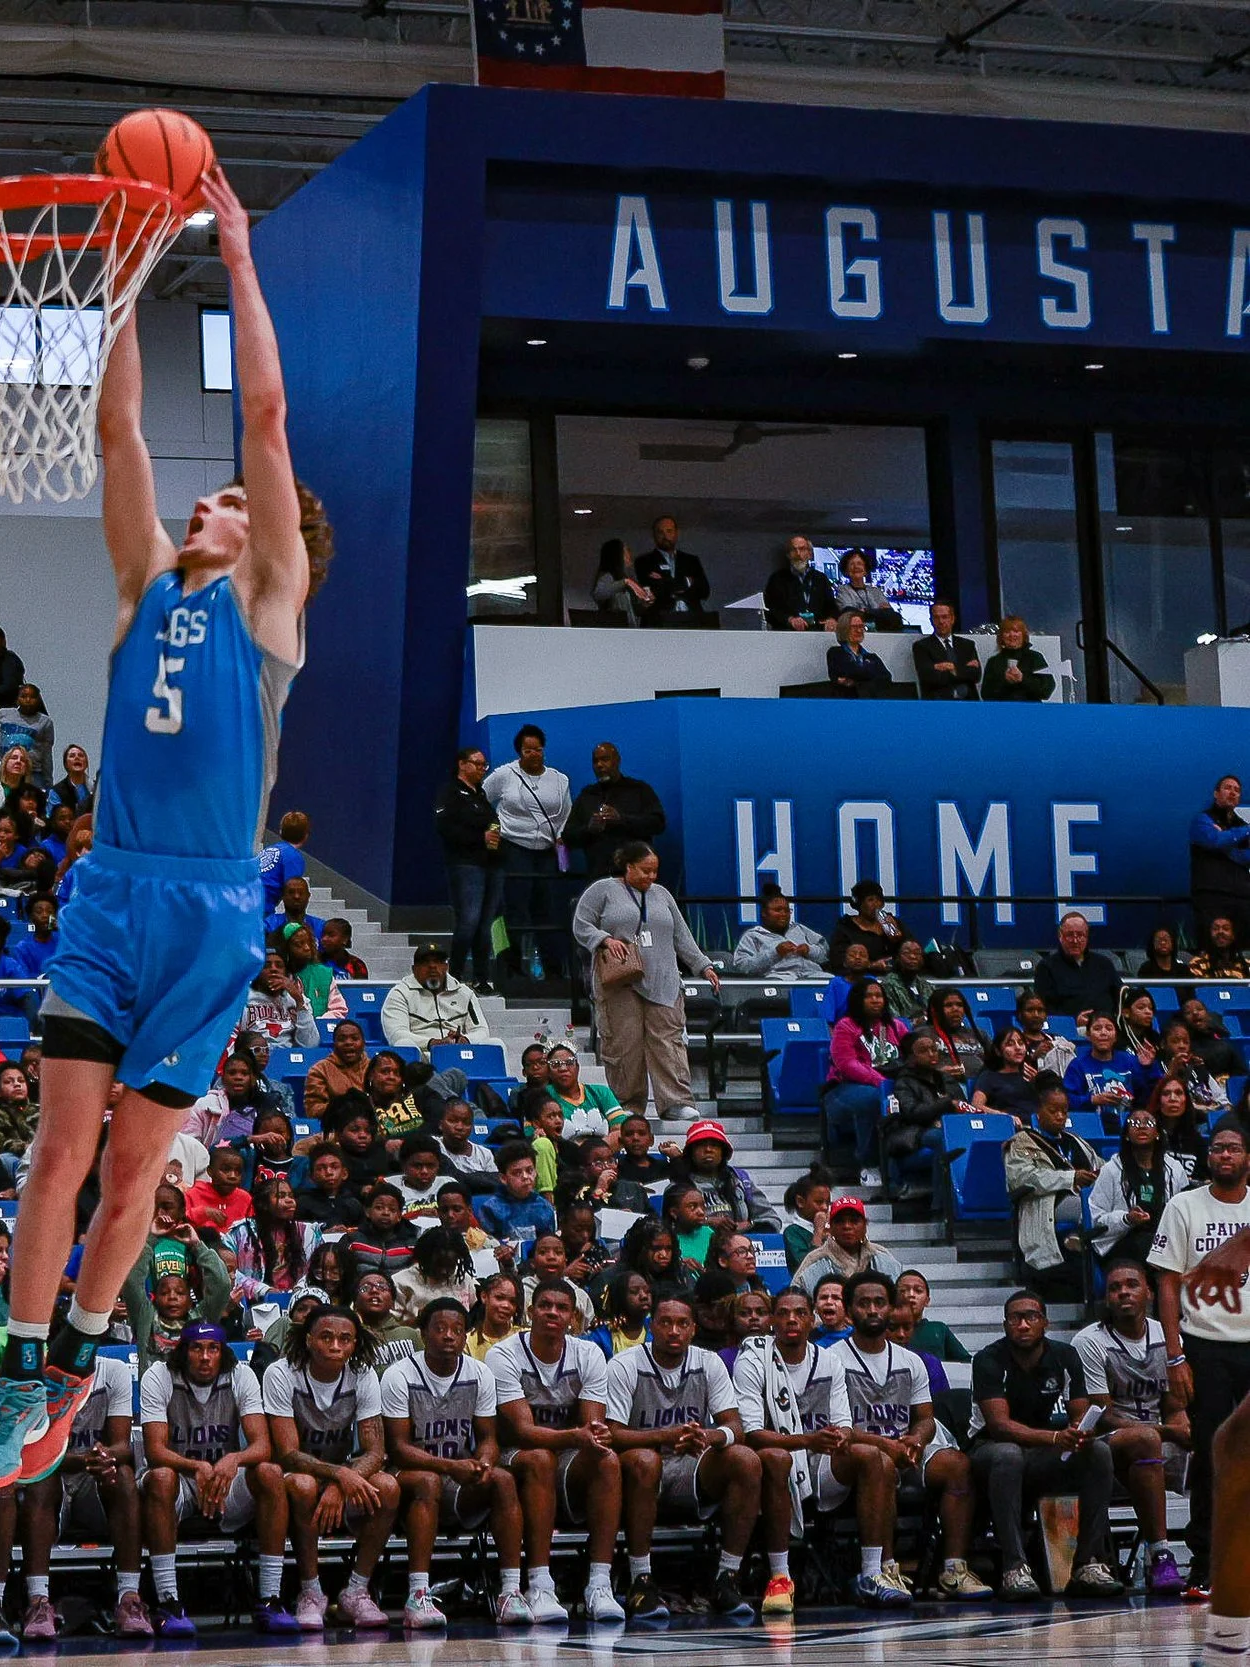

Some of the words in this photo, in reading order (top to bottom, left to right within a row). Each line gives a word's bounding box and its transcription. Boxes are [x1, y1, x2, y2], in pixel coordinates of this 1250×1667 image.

[144, 653, 186, 734] 5
[734, 799, 1107, 926] HOME
[246, 1002, 298, 1025] BULLS
[639, 1404, 702, 1429] LIONS
[853, 1403, 910, 1424] LIONS
[172, 1424, 231, 1445] LIONS
